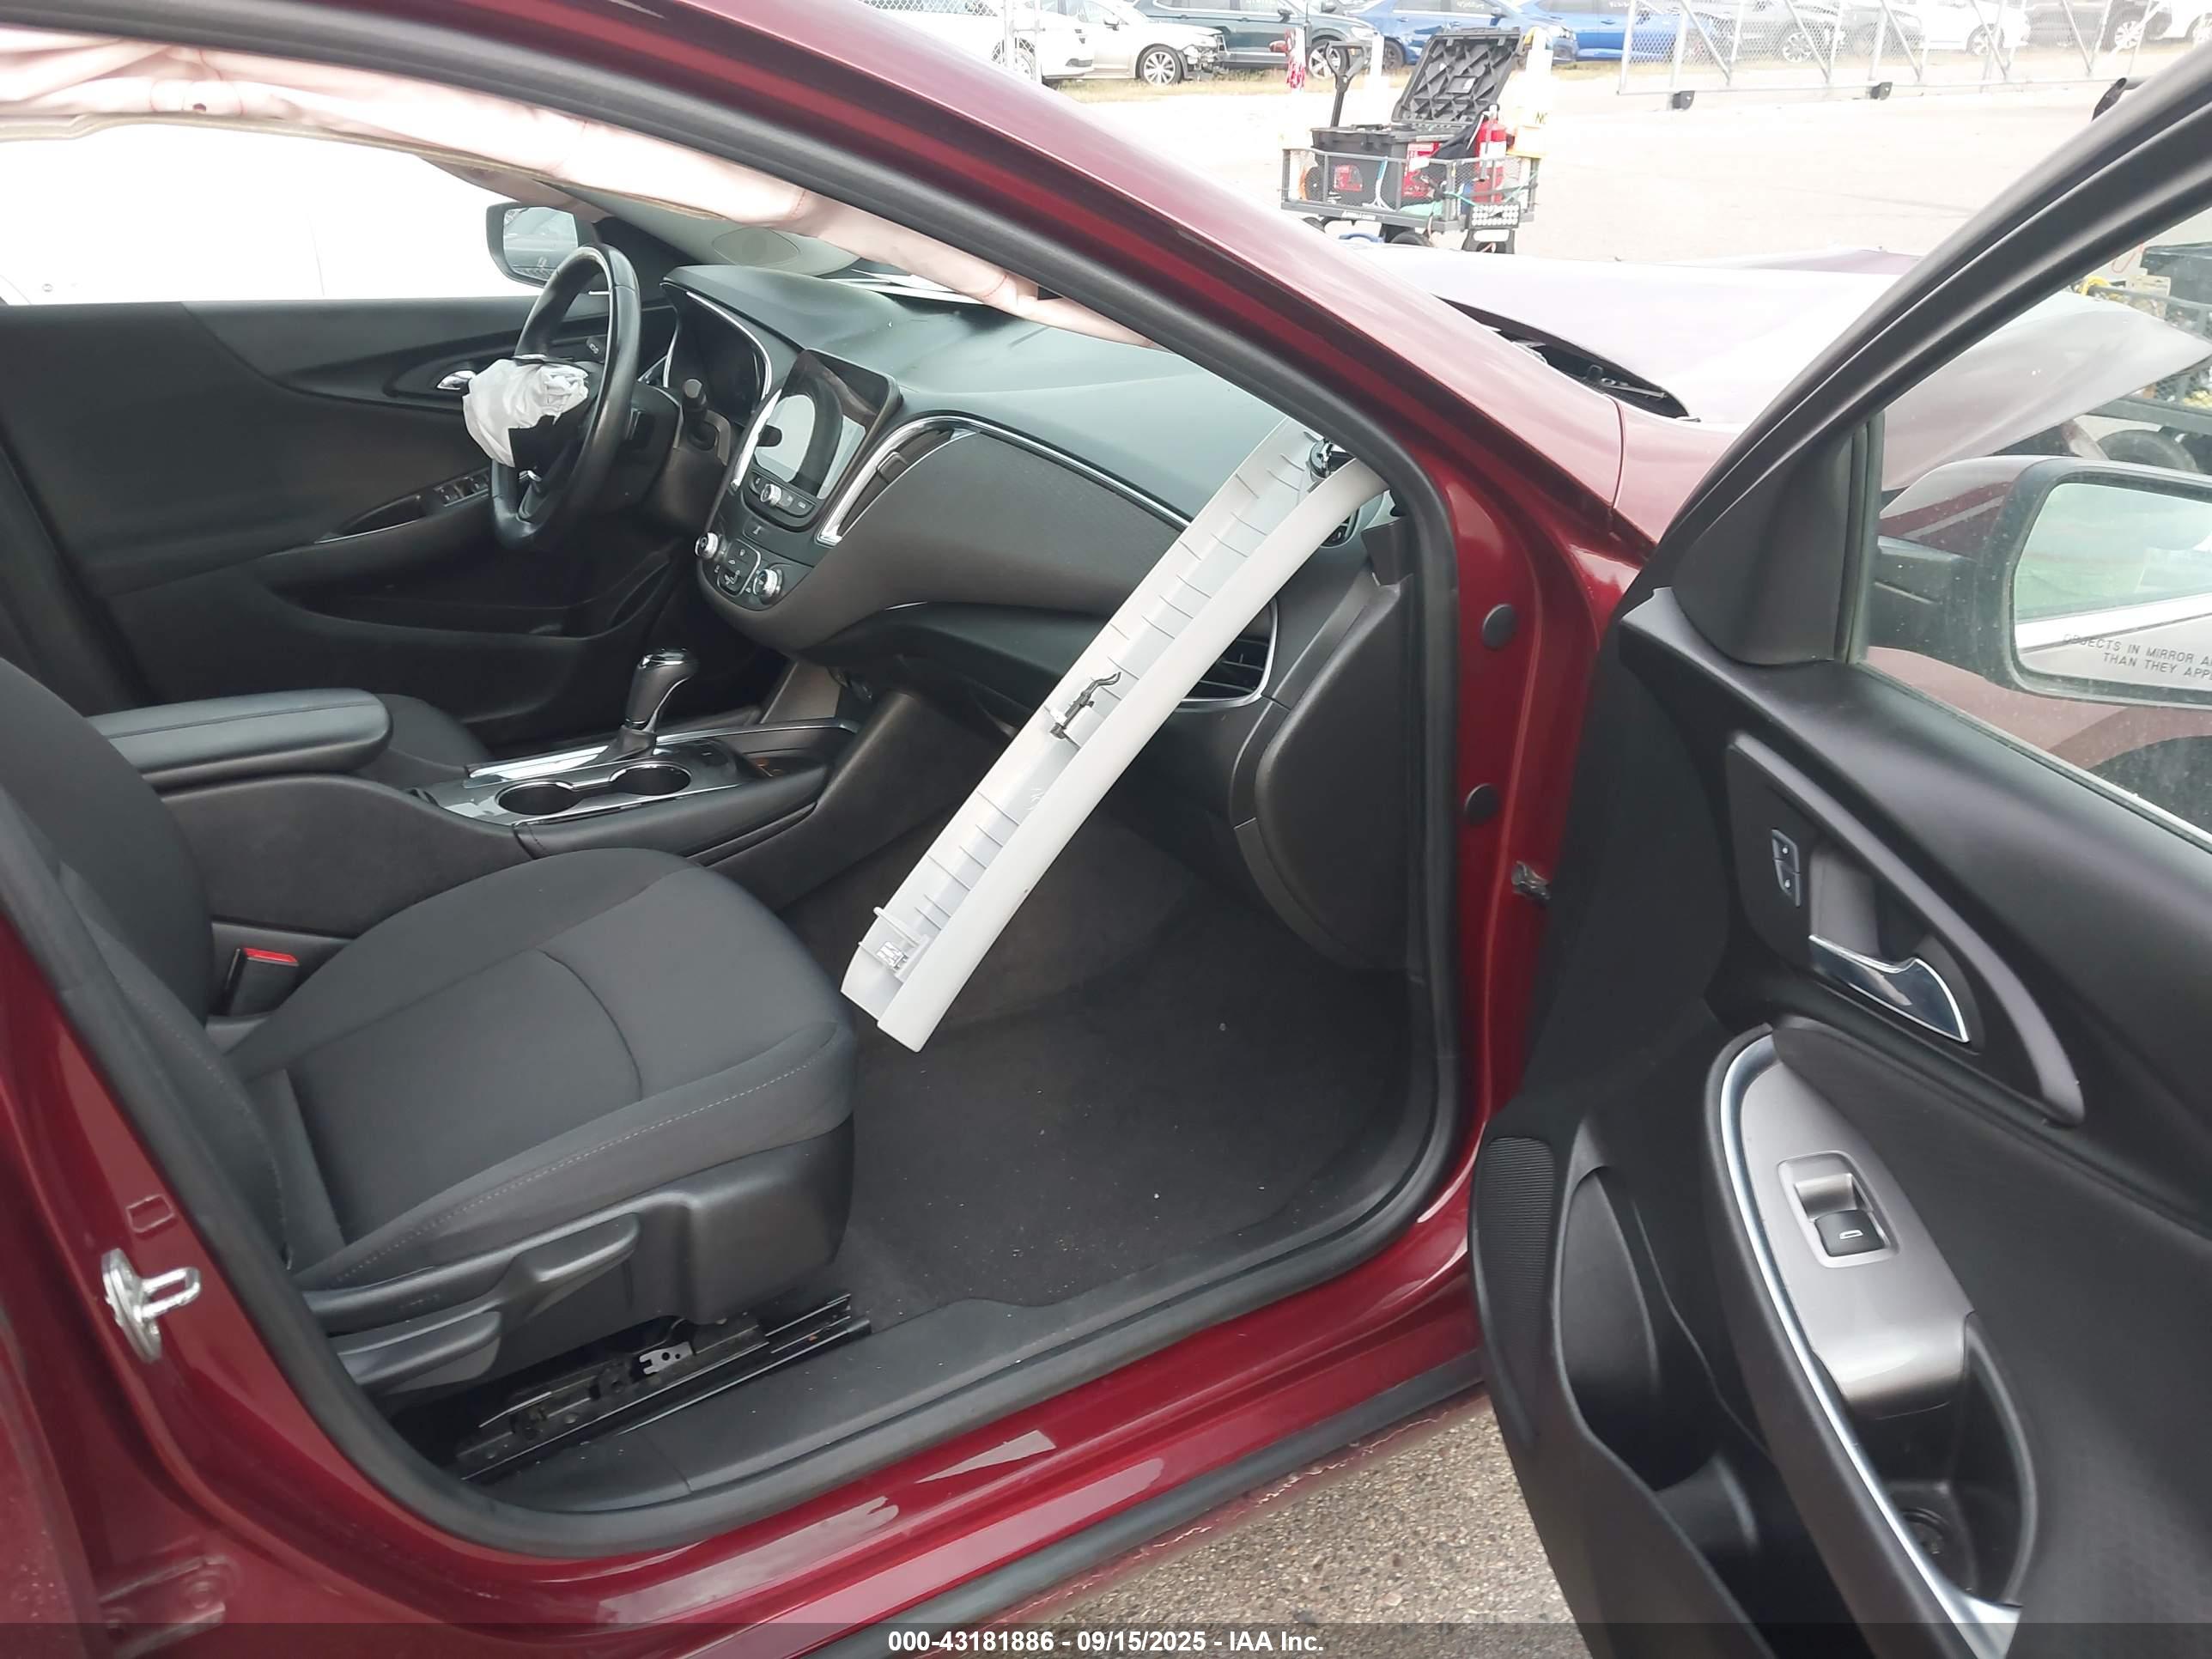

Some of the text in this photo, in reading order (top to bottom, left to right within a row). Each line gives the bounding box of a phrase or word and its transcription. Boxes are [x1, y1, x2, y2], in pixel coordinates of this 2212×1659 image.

[2103, 653, 2138, 667] THAN
[2144, 659, 2179, 674] THEY
[2127, 644, 2141, 655] IN
[2146, 647, 2195, 664] MIRROR
[2200, 655, 2212, 667] A
